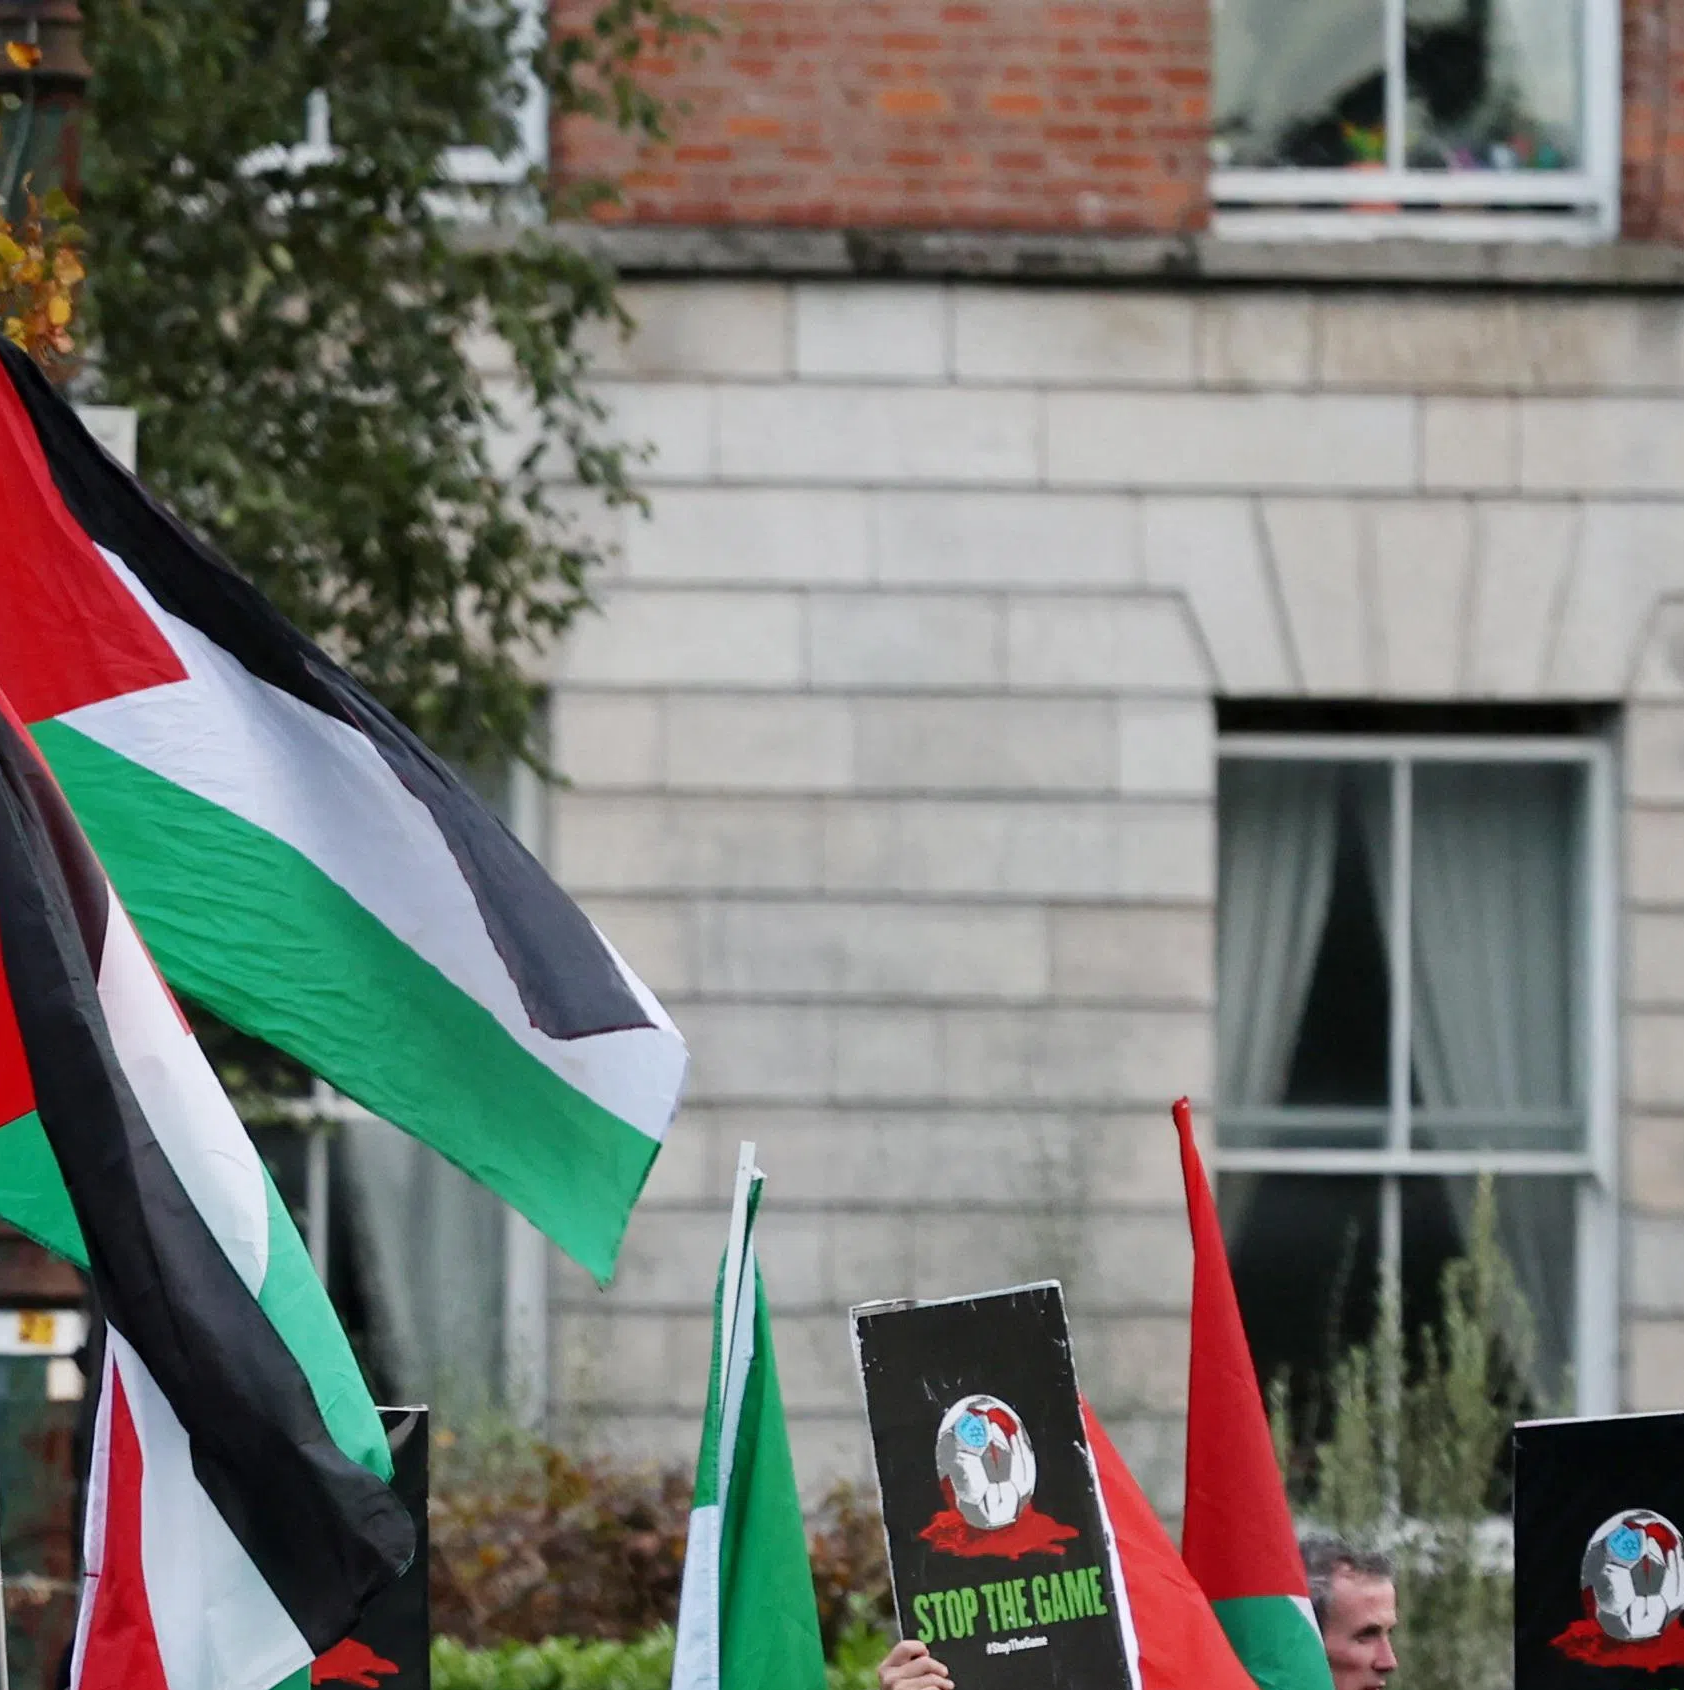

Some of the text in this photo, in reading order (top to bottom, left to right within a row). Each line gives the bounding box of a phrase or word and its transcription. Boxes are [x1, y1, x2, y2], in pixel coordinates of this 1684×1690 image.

[913, 1566, 1108, 1644] STOP THE GAME
[985, 1636, 1049, 1656] #StopTheGame
